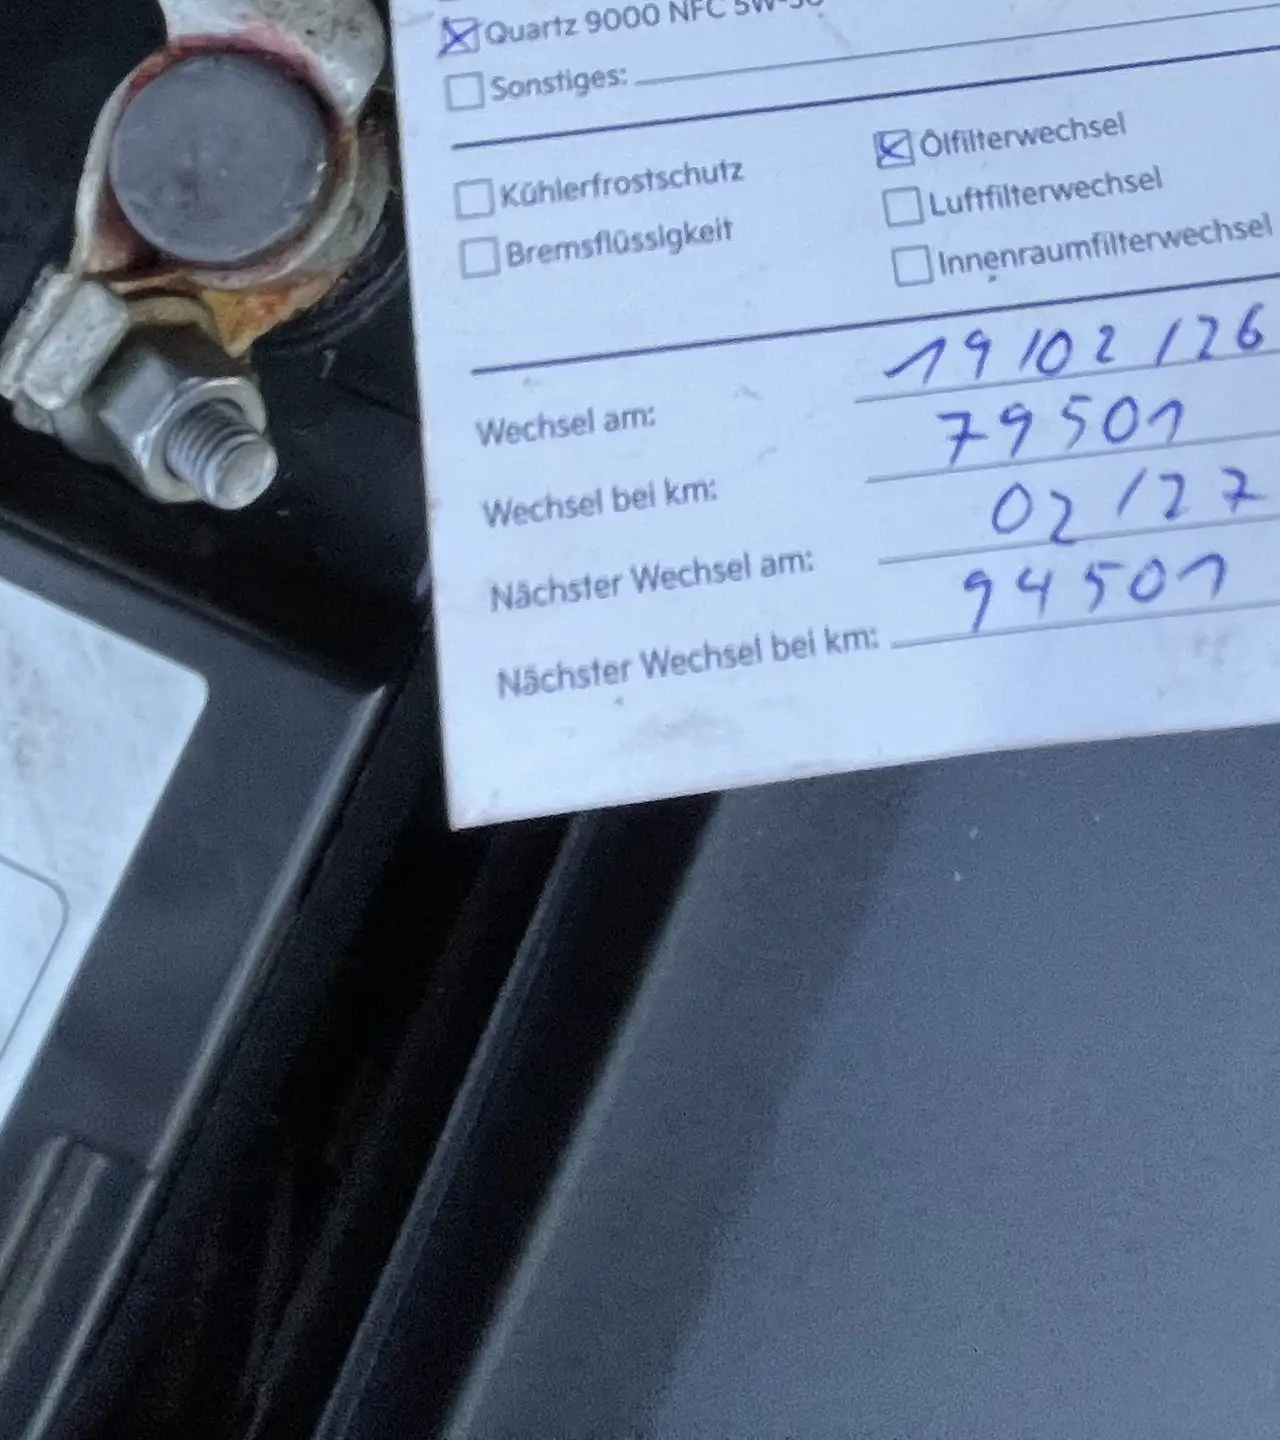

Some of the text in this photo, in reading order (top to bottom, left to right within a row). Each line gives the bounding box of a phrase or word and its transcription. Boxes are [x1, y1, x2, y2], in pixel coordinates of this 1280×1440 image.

[486, 15, 578, 46] Quartz
[586, 3, 660, 32] 9000
[490, 64, 627, 102] Sonstiges:
[920, 112, 1127, 158] Ölfilterwechsel
[501, 157, 745, 208] Kühlerfrostschutz
[929, 167, 1163, 217] Luftfilterwechsel
[507, 217, 734, 268] Bremsflüssigkeit
[938, 213, 1273, 274] Innenraumfilterwechsel
[476, 405, 655, 447] Wechsel am:
[937, 395, 1184, 465] 79501
[483, 475, 718, 529] Wechsel bei km:
[490, 549, 813, 612] Nächster Wechsel am:
[963, 552, 1227, 634] 94501
[497, 626, 878, 700] Nächster Wechsel bei km:
